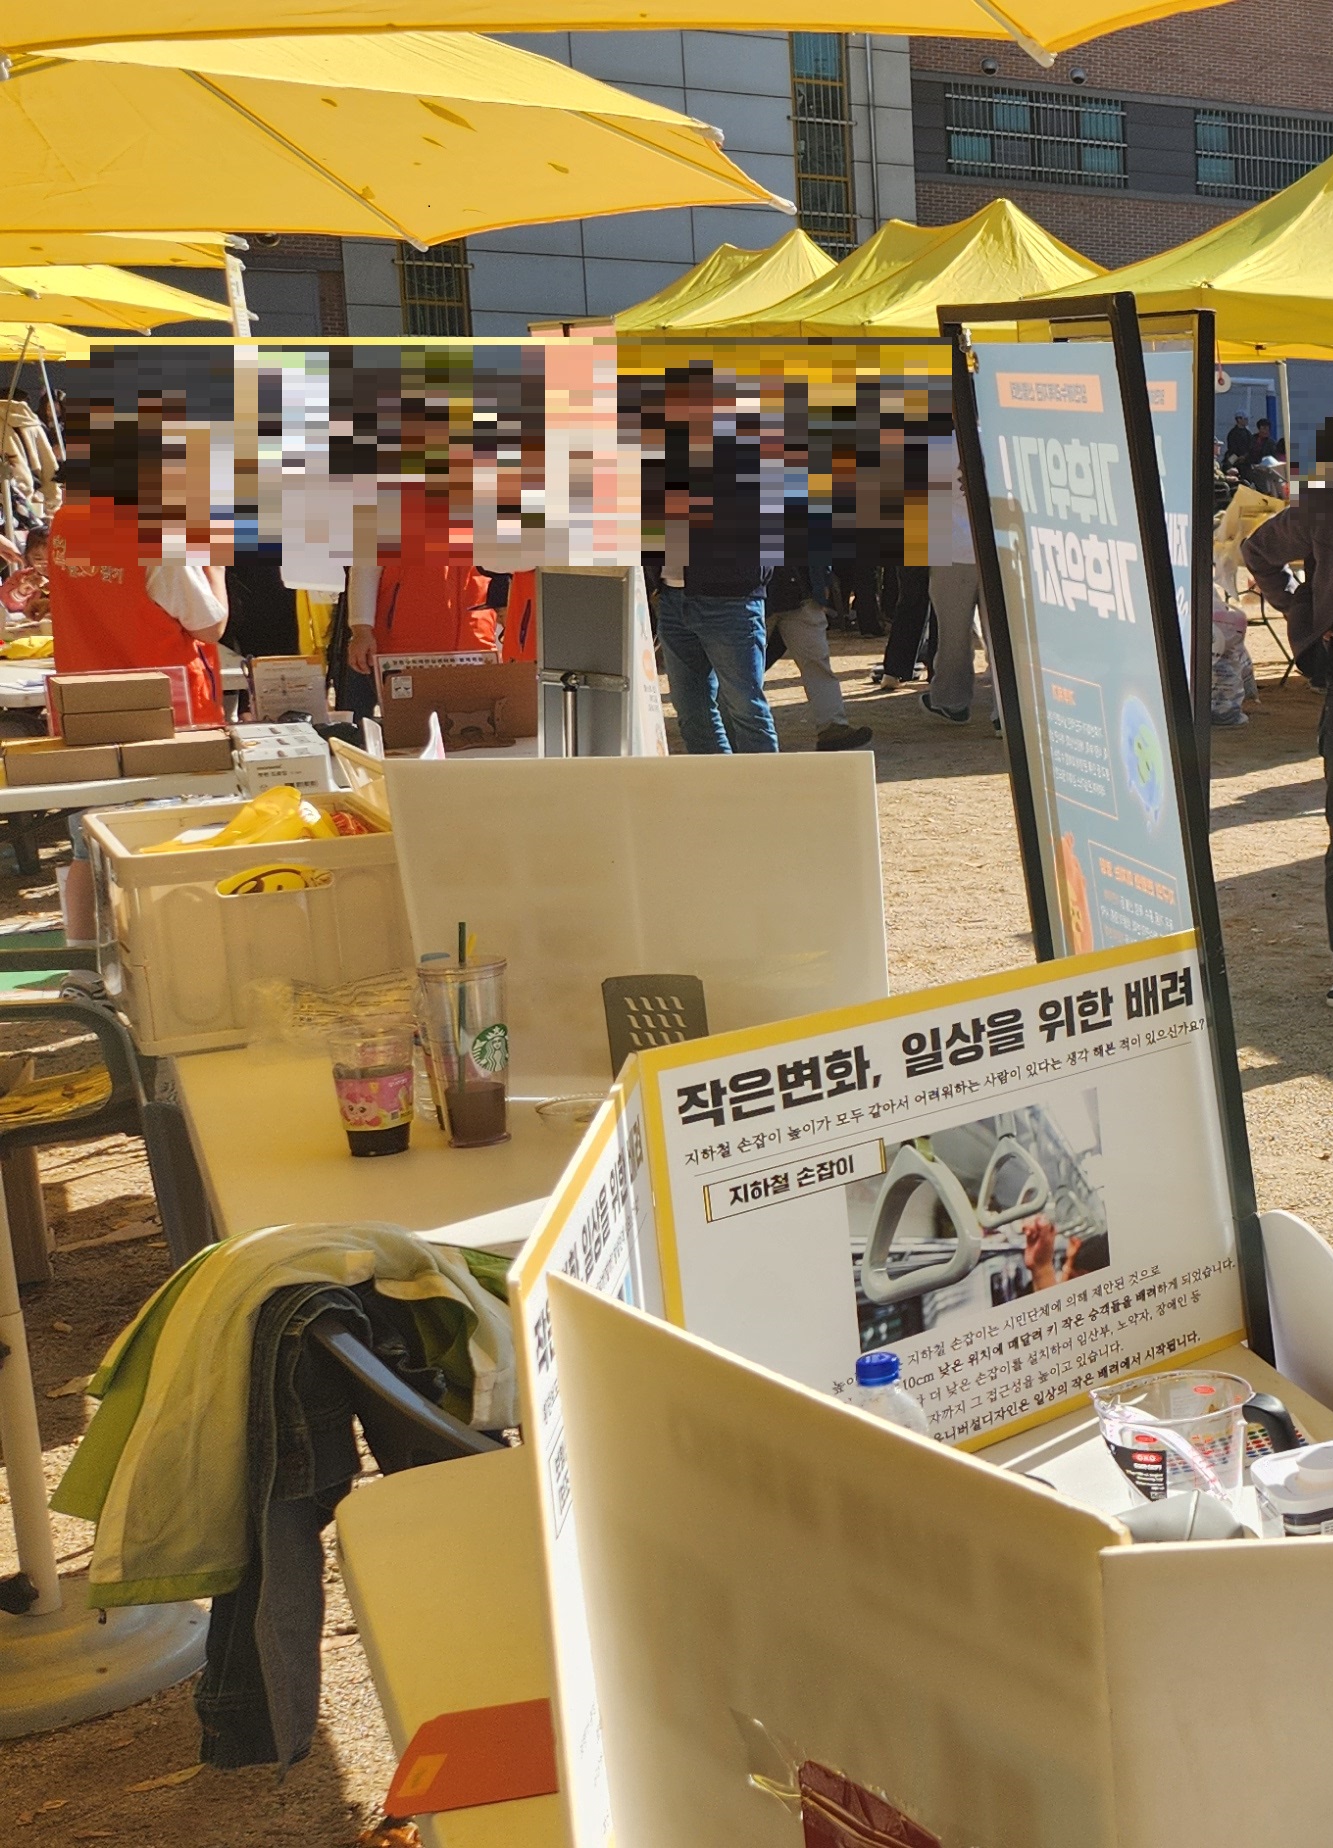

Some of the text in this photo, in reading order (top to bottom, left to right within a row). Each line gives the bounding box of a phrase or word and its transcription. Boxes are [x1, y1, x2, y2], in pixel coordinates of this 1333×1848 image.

[677, 967, 1193, 1127] 작은변화, 일상을 위한 배려
[684, 1018, 1206, 1166] 지하철 손잡이 높이가 모두 같아서 어려워하는 사람이 있다는 생각 해본 적이 있으신가요?
[729, 1155, 855, 1206] 지하철 손잡이
[908, 1341, 946, 1365] 지하철
[950, 1326, 1000, 1351] 손잡이는
[1003, 1299, 1062, 1330] 시민단체에
[1066, 1290, 1088, 1307] 의해
[1092, 1277, 1125, 1297] 제안된
[1129, 1265, 1161, 1286] 것으로
[938, 1358, 964, 1379] 낮은
[968, 1342, 1004, 1366] 위치에
[1008, 1328, 1043, 1350] 매달려
[1047, 1321, 1058, 1335] 키
[1062, 1314, 1085, 1330] 작은
[1088, 1295, 1132, 1321] 승객들을
[1135, 1278, 1178, 1301] 배려하게
[1181, 1257, 1236, 1284] 되었습니다.
[946, 1377, 971, 1396] 낮은
[975, 1357, 1023, 1386] 손잡이를
[1027, 1340, 1073, 1366] 설치하여
[1077, 1323, 1114, 1346] 임산부,
[1117, 1309, 1153, 1331] 노약자,
[1155, 1295, 1188, 1317] 장애인
[1190, 1290, 1201, 1303] 등
[970, 1396, 983, 1409] 그
[986, 1375, 1035, 1403] 접근성을
[1038, 1363, 1073, 1384] 높이고
[1076, 1340, 1124, 1368] 있습니다.
[1033, 1382, 1068, 1405] 일상의
[1071, 1373, 1094, 1388] 작은
[1097, 1353, 1141, 1379] 배려에서
[1145, 1331, 1201, 1360] 시작됩니다.
